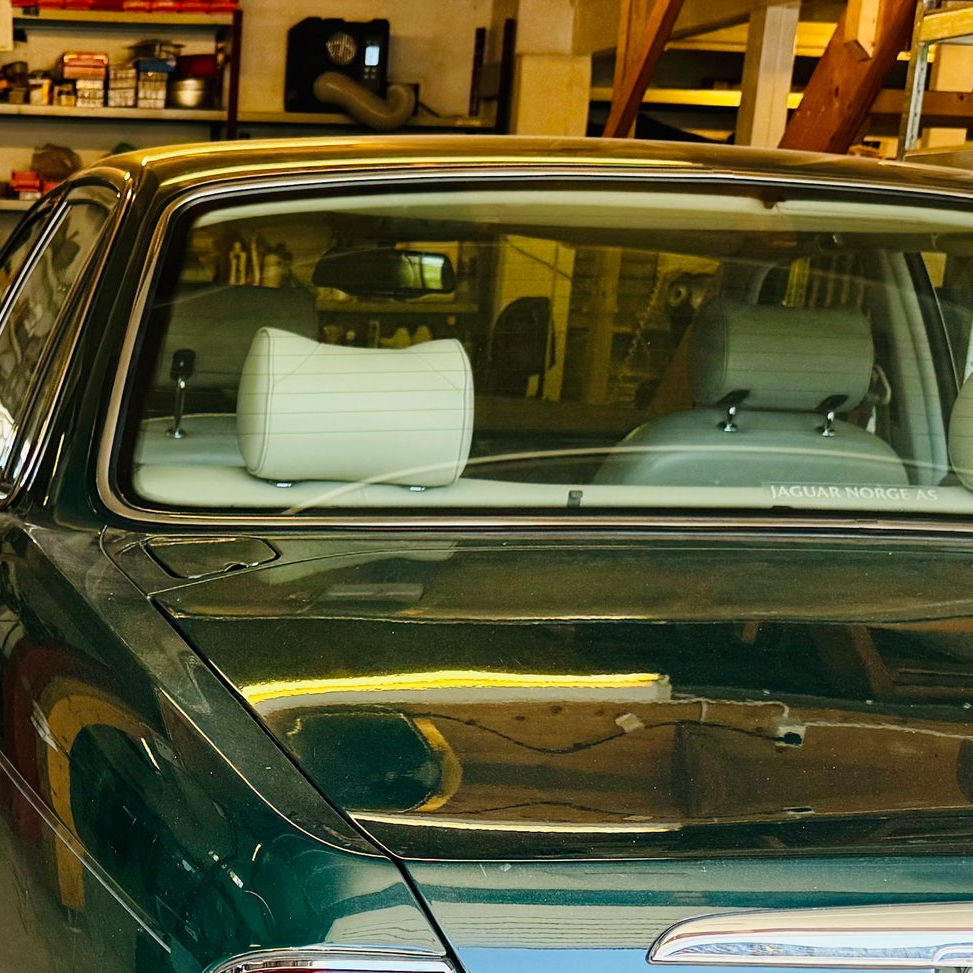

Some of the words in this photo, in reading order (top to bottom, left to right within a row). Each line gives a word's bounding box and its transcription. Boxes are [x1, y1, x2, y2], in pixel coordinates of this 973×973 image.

[770, 485, 842, 499] JAGUAR
[844, 487, 909, 501] NORGE
[916, 489, 939, 501] AS
